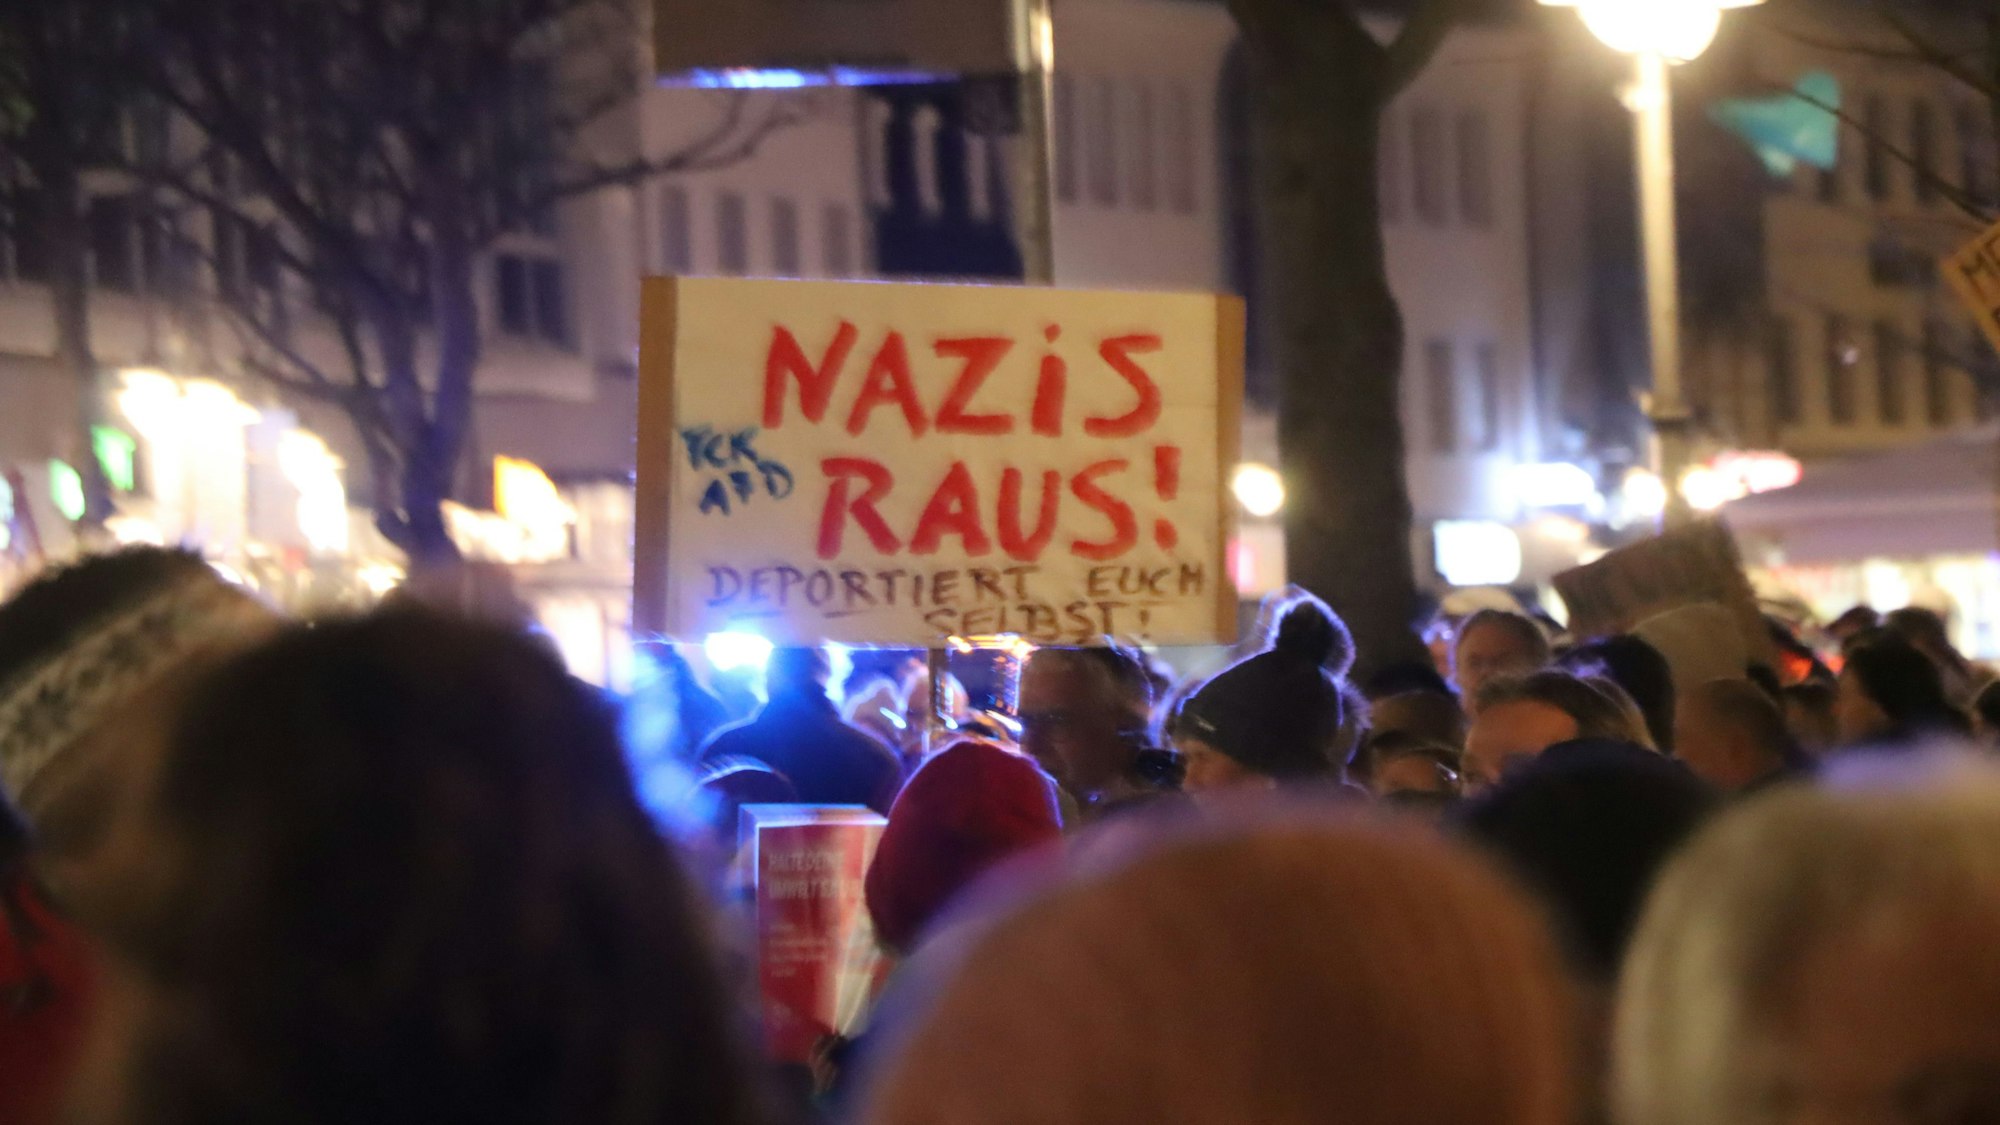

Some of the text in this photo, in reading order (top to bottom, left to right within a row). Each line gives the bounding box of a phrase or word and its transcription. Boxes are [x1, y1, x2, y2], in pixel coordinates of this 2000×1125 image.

[816, 446, 1181, 562] RAUS!
[706, 562, 1206, 608] DEPORTIERT EUCH
[923, 603, 1152, 643] SELBST!
